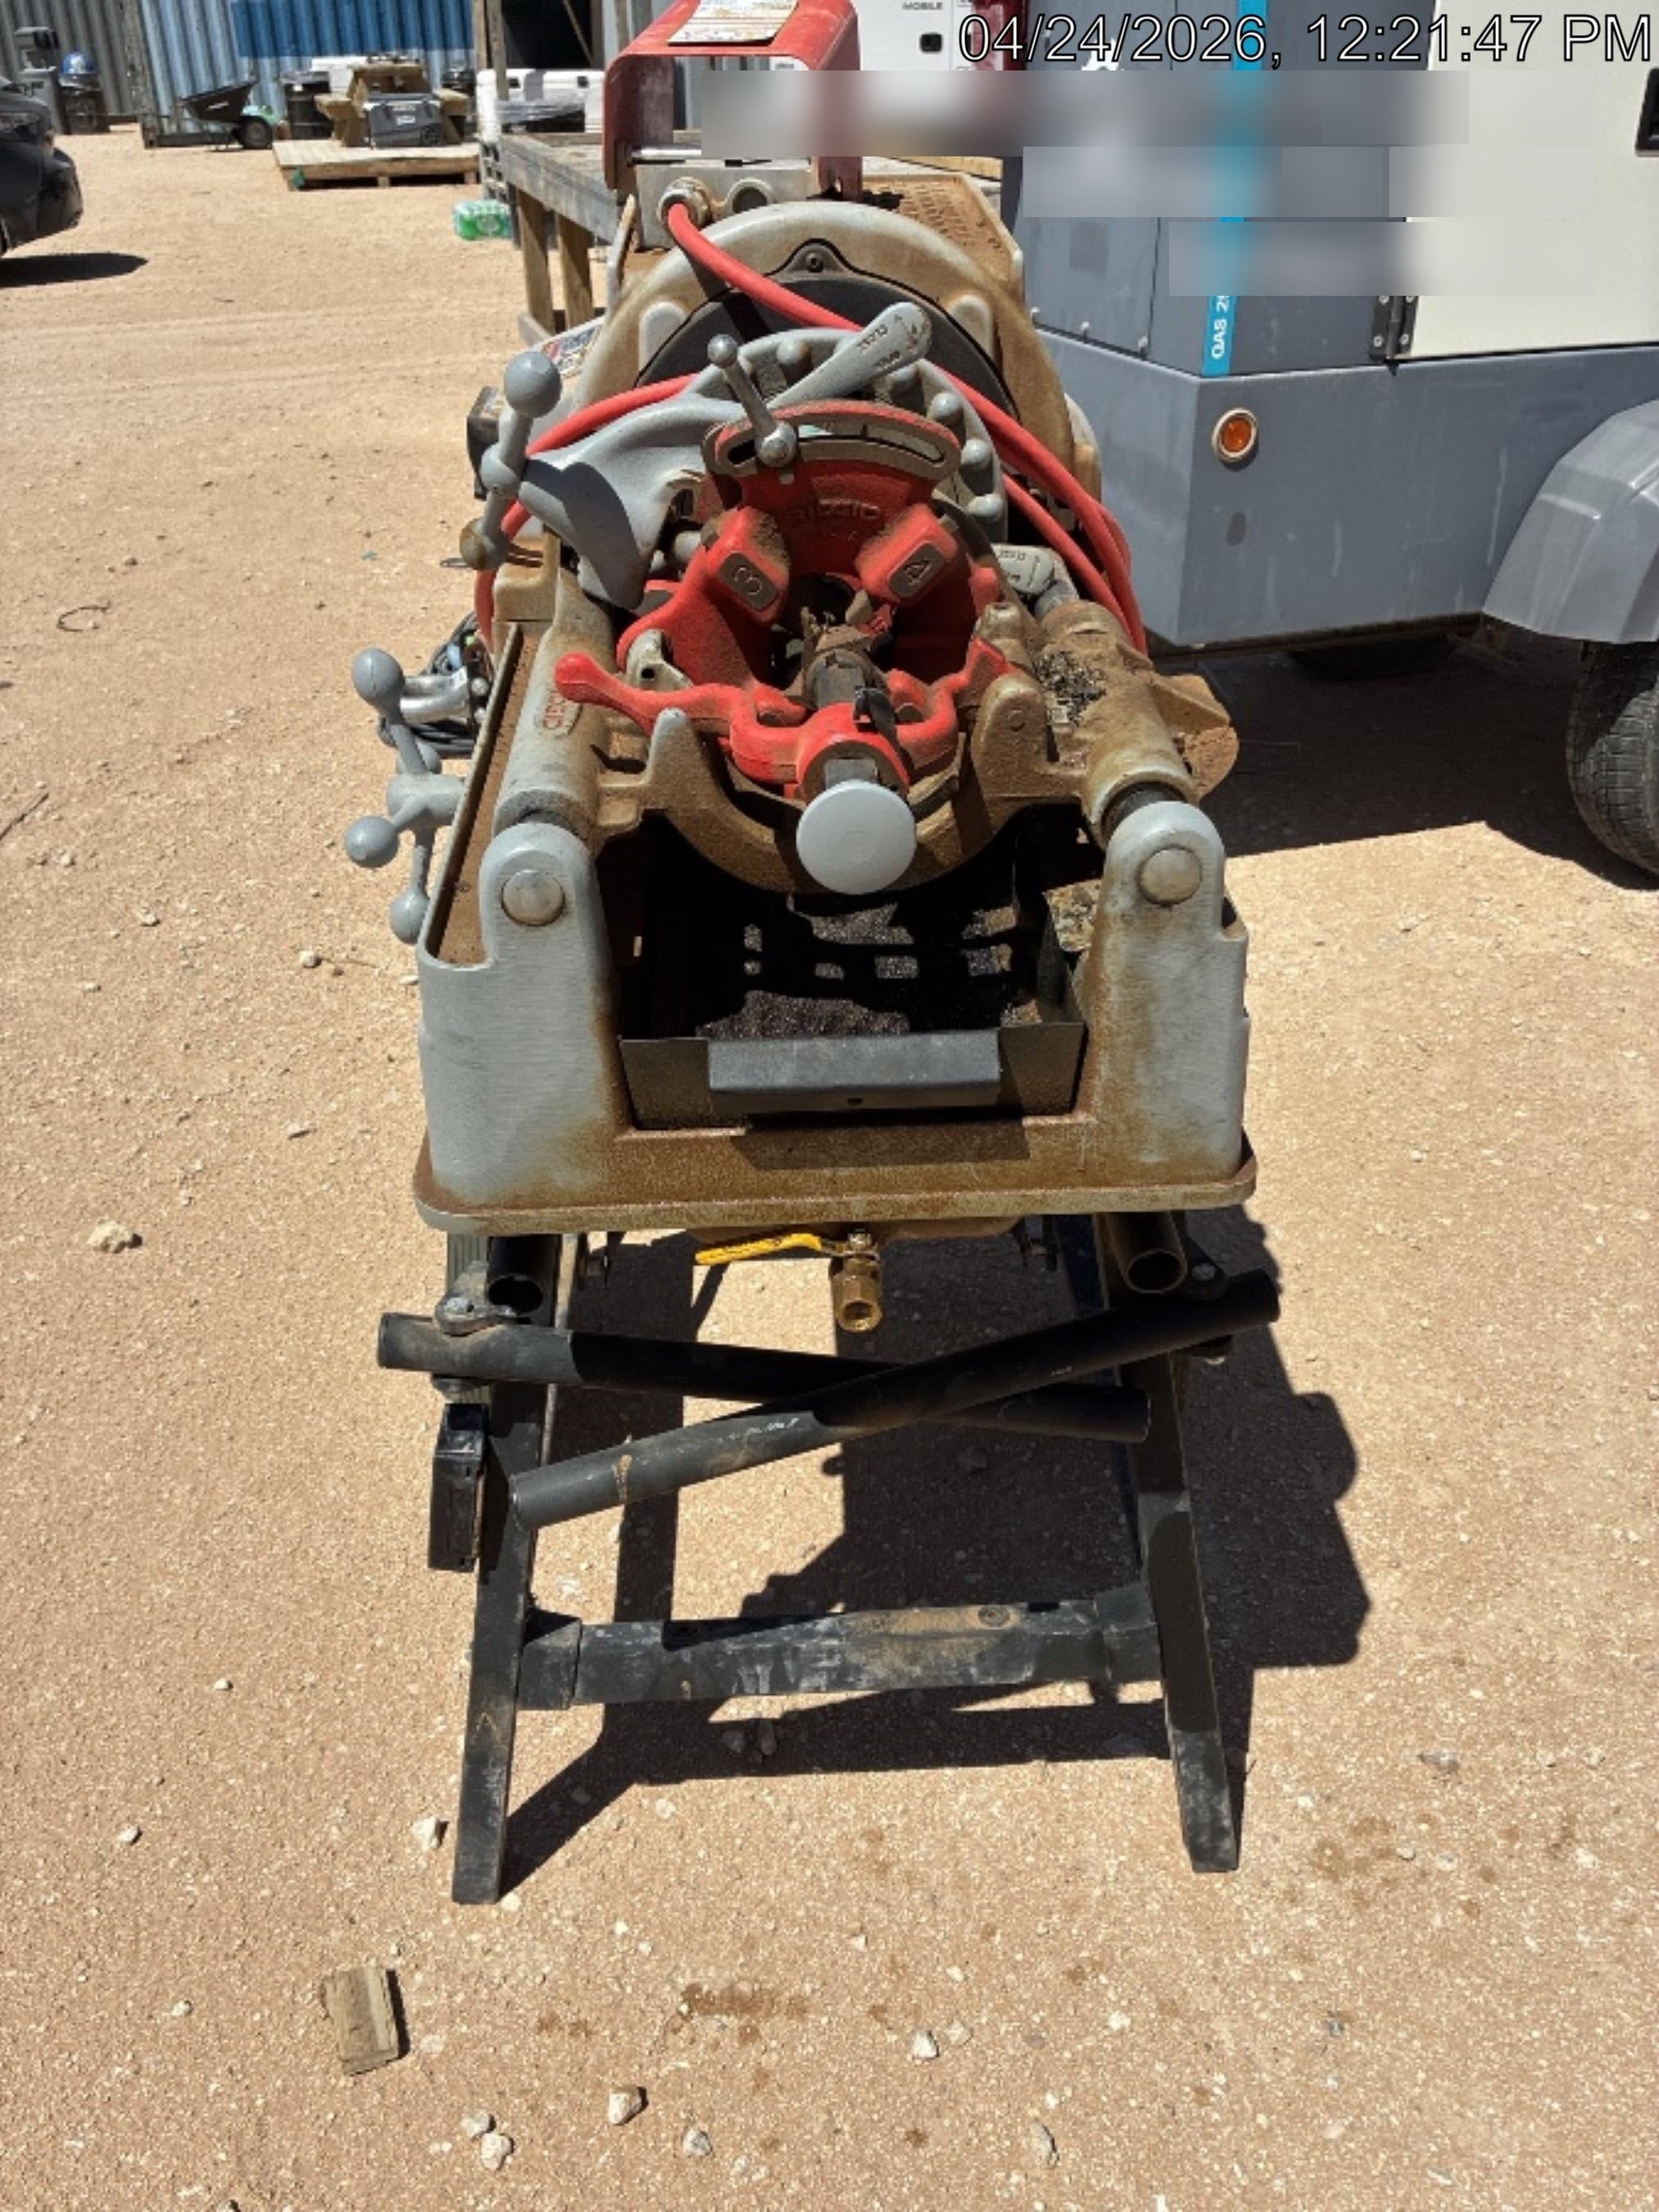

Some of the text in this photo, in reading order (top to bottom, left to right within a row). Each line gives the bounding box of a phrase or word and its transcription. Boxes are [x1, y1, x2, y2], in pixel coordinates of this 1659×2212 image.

[902, 1, 943, 11] MOBILE
[1211, 318, 1227, 360] QAS
[733, 566, 763, 596] 3
[903, 560, 931, 587] 4
